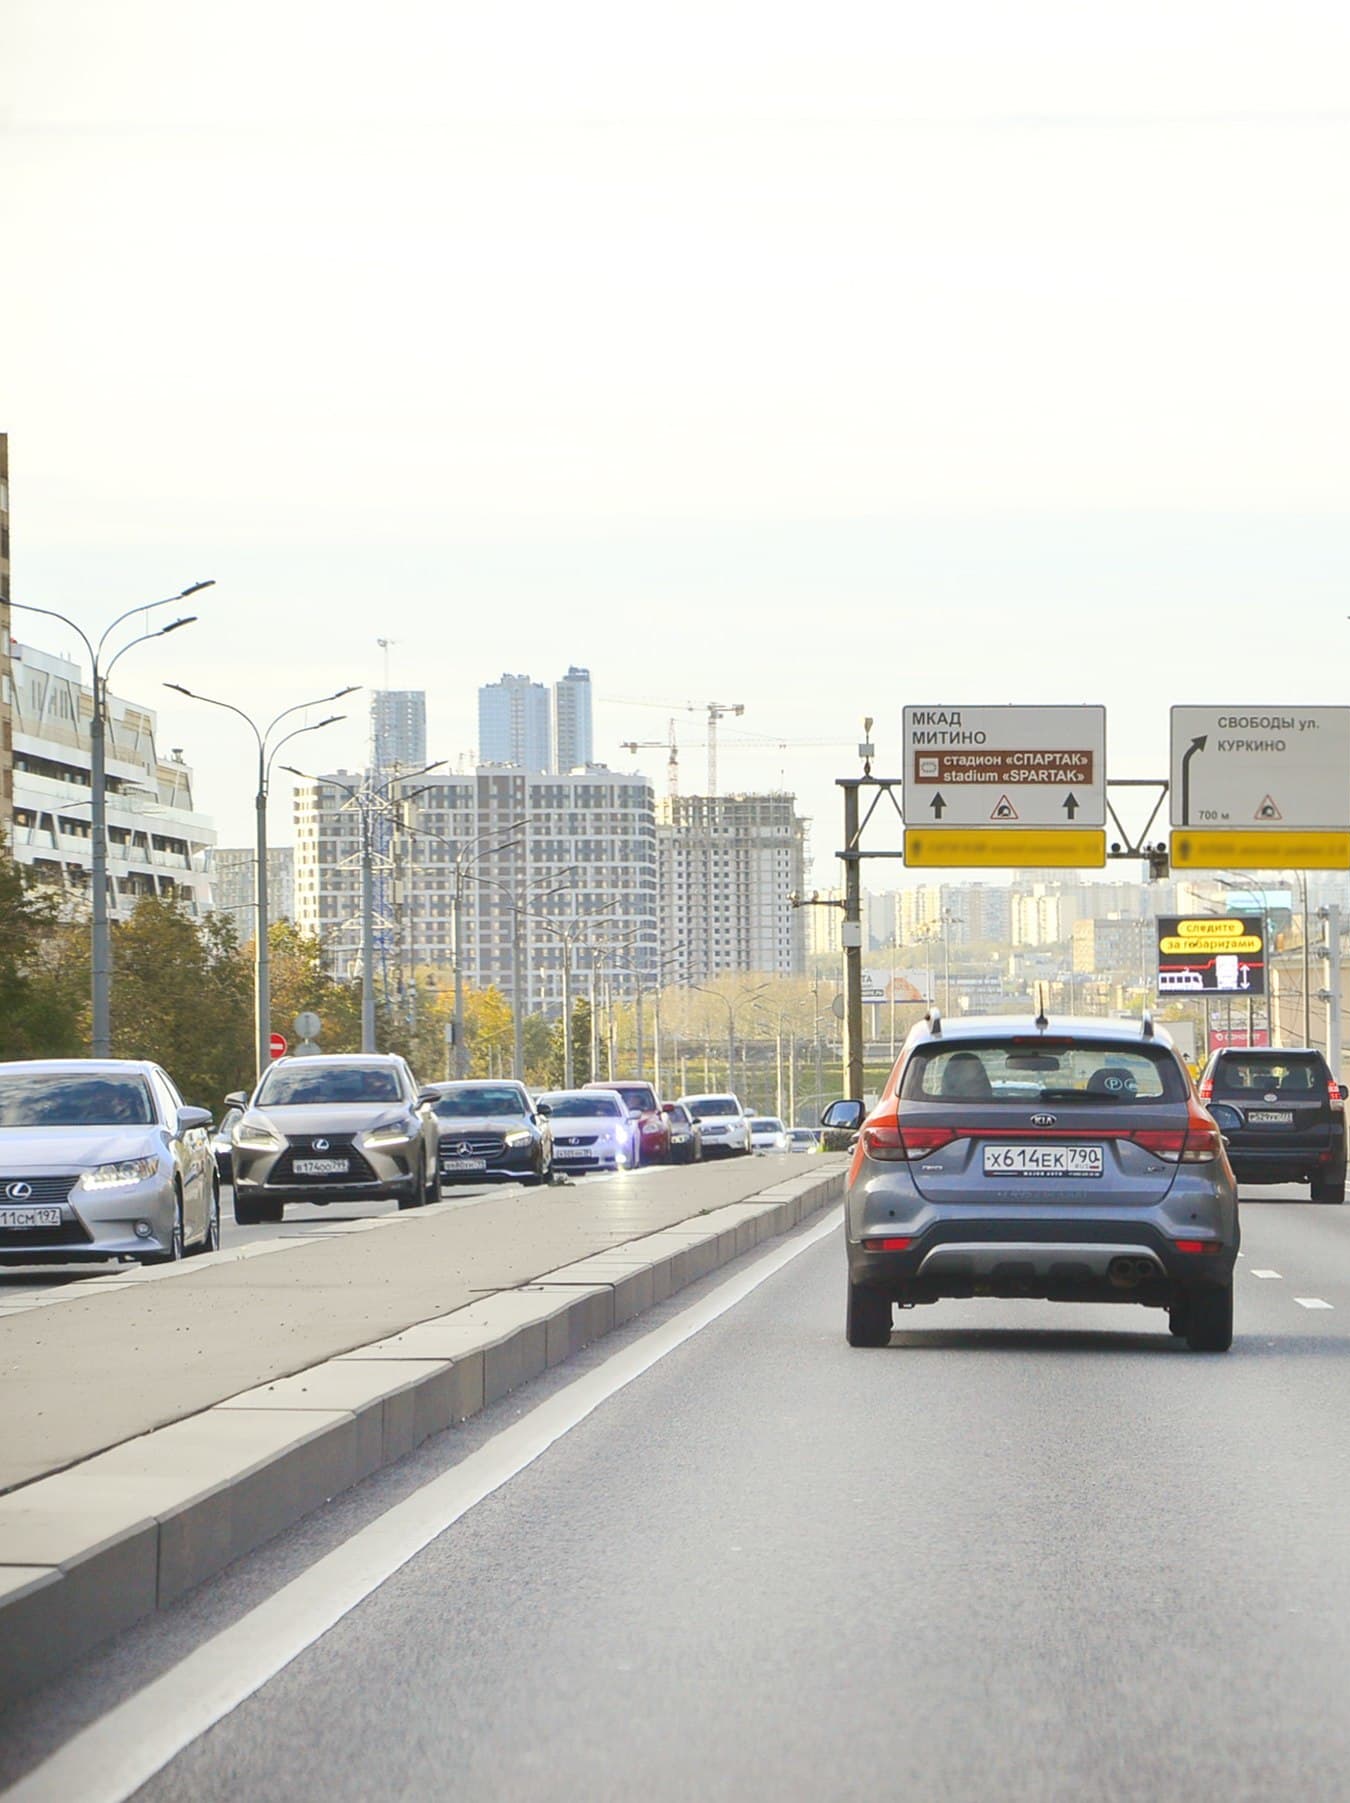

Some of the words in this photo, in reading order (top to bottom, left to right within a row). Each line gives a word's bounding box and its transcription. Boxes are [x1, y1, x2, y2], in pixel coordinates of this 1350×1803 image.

[912, 711, 962, 727] МКАД
[1217, 716, 1295, 730] СВОБОДЫ
[1298, 719, 1320, 731] ул.
[912, 731, 987, 745] МИТИНО
[1217, 739, 1286, 752] КУРКИНО
[943, 755, 1001, 767] стадион
[1005, 753, 1088, 766] «СПАРТАК»
[943, 770, 999, 782] stadium
[1002, 769, 1085, 782] «SPARTAK»
[1199, 811, 1218, 820] 700
[1186, 924, 1236, 933] следите
[1167, 941, 1181, 950] за
[1034, 1115, 1053, 1125] KIA
